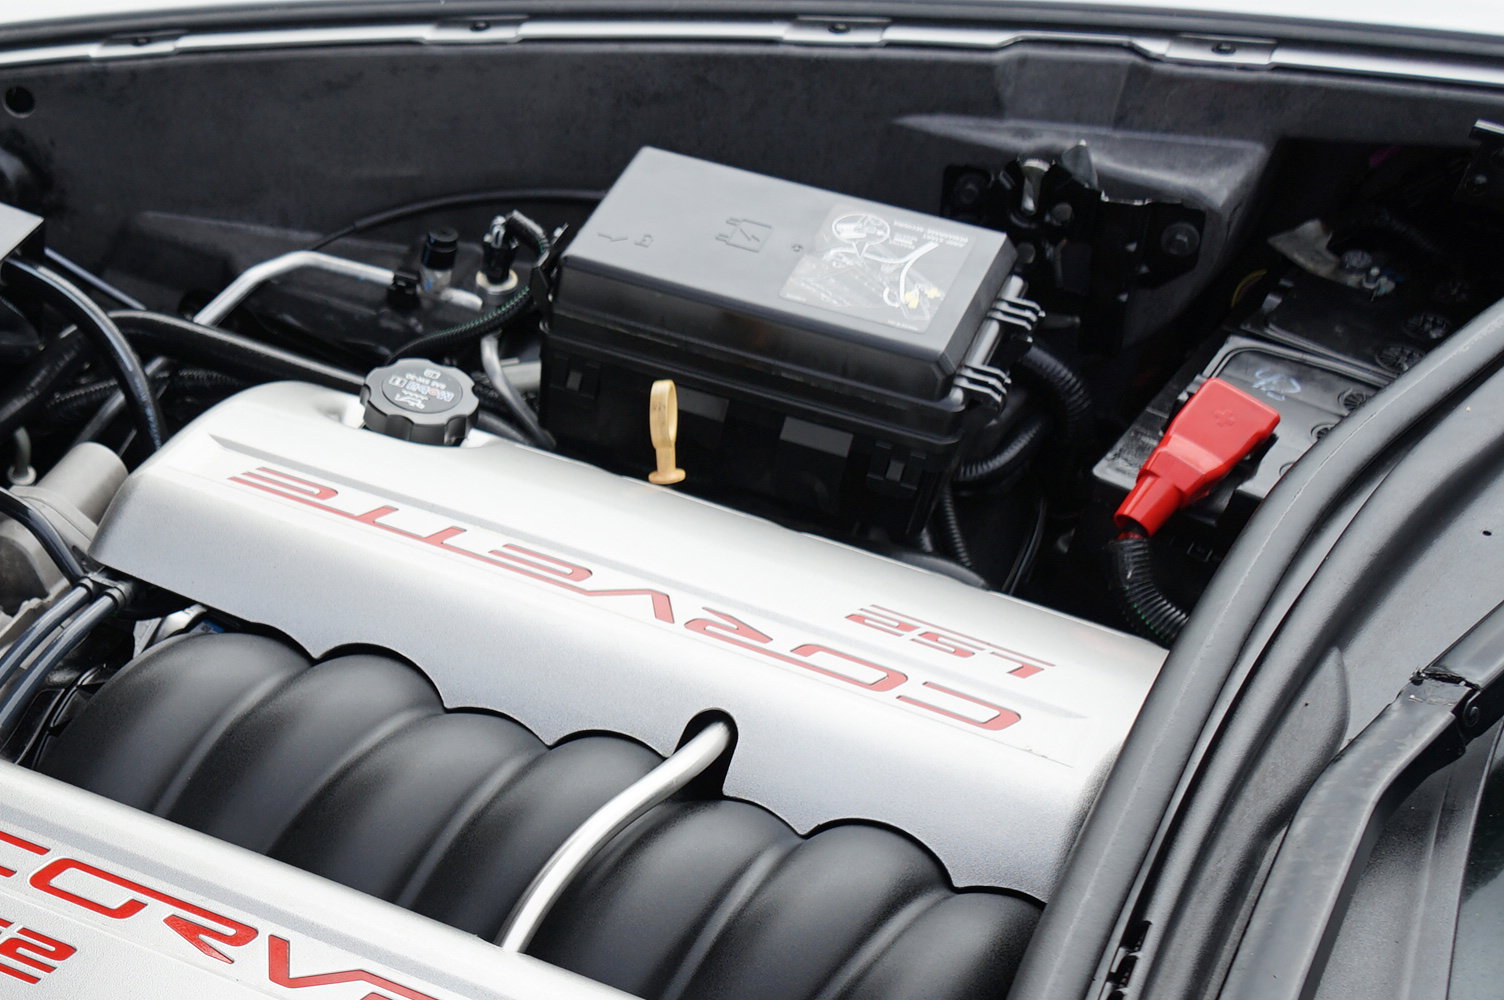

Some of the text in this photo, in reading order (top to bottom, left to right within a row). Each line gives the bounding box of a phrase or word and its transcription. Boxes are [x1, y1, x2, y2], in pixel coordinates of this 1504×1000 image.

[405, 380, 455, 402] Mobil
[229, 467, 1022, 731] CORVETTE
[845, 606, 1045, 679] LS2
